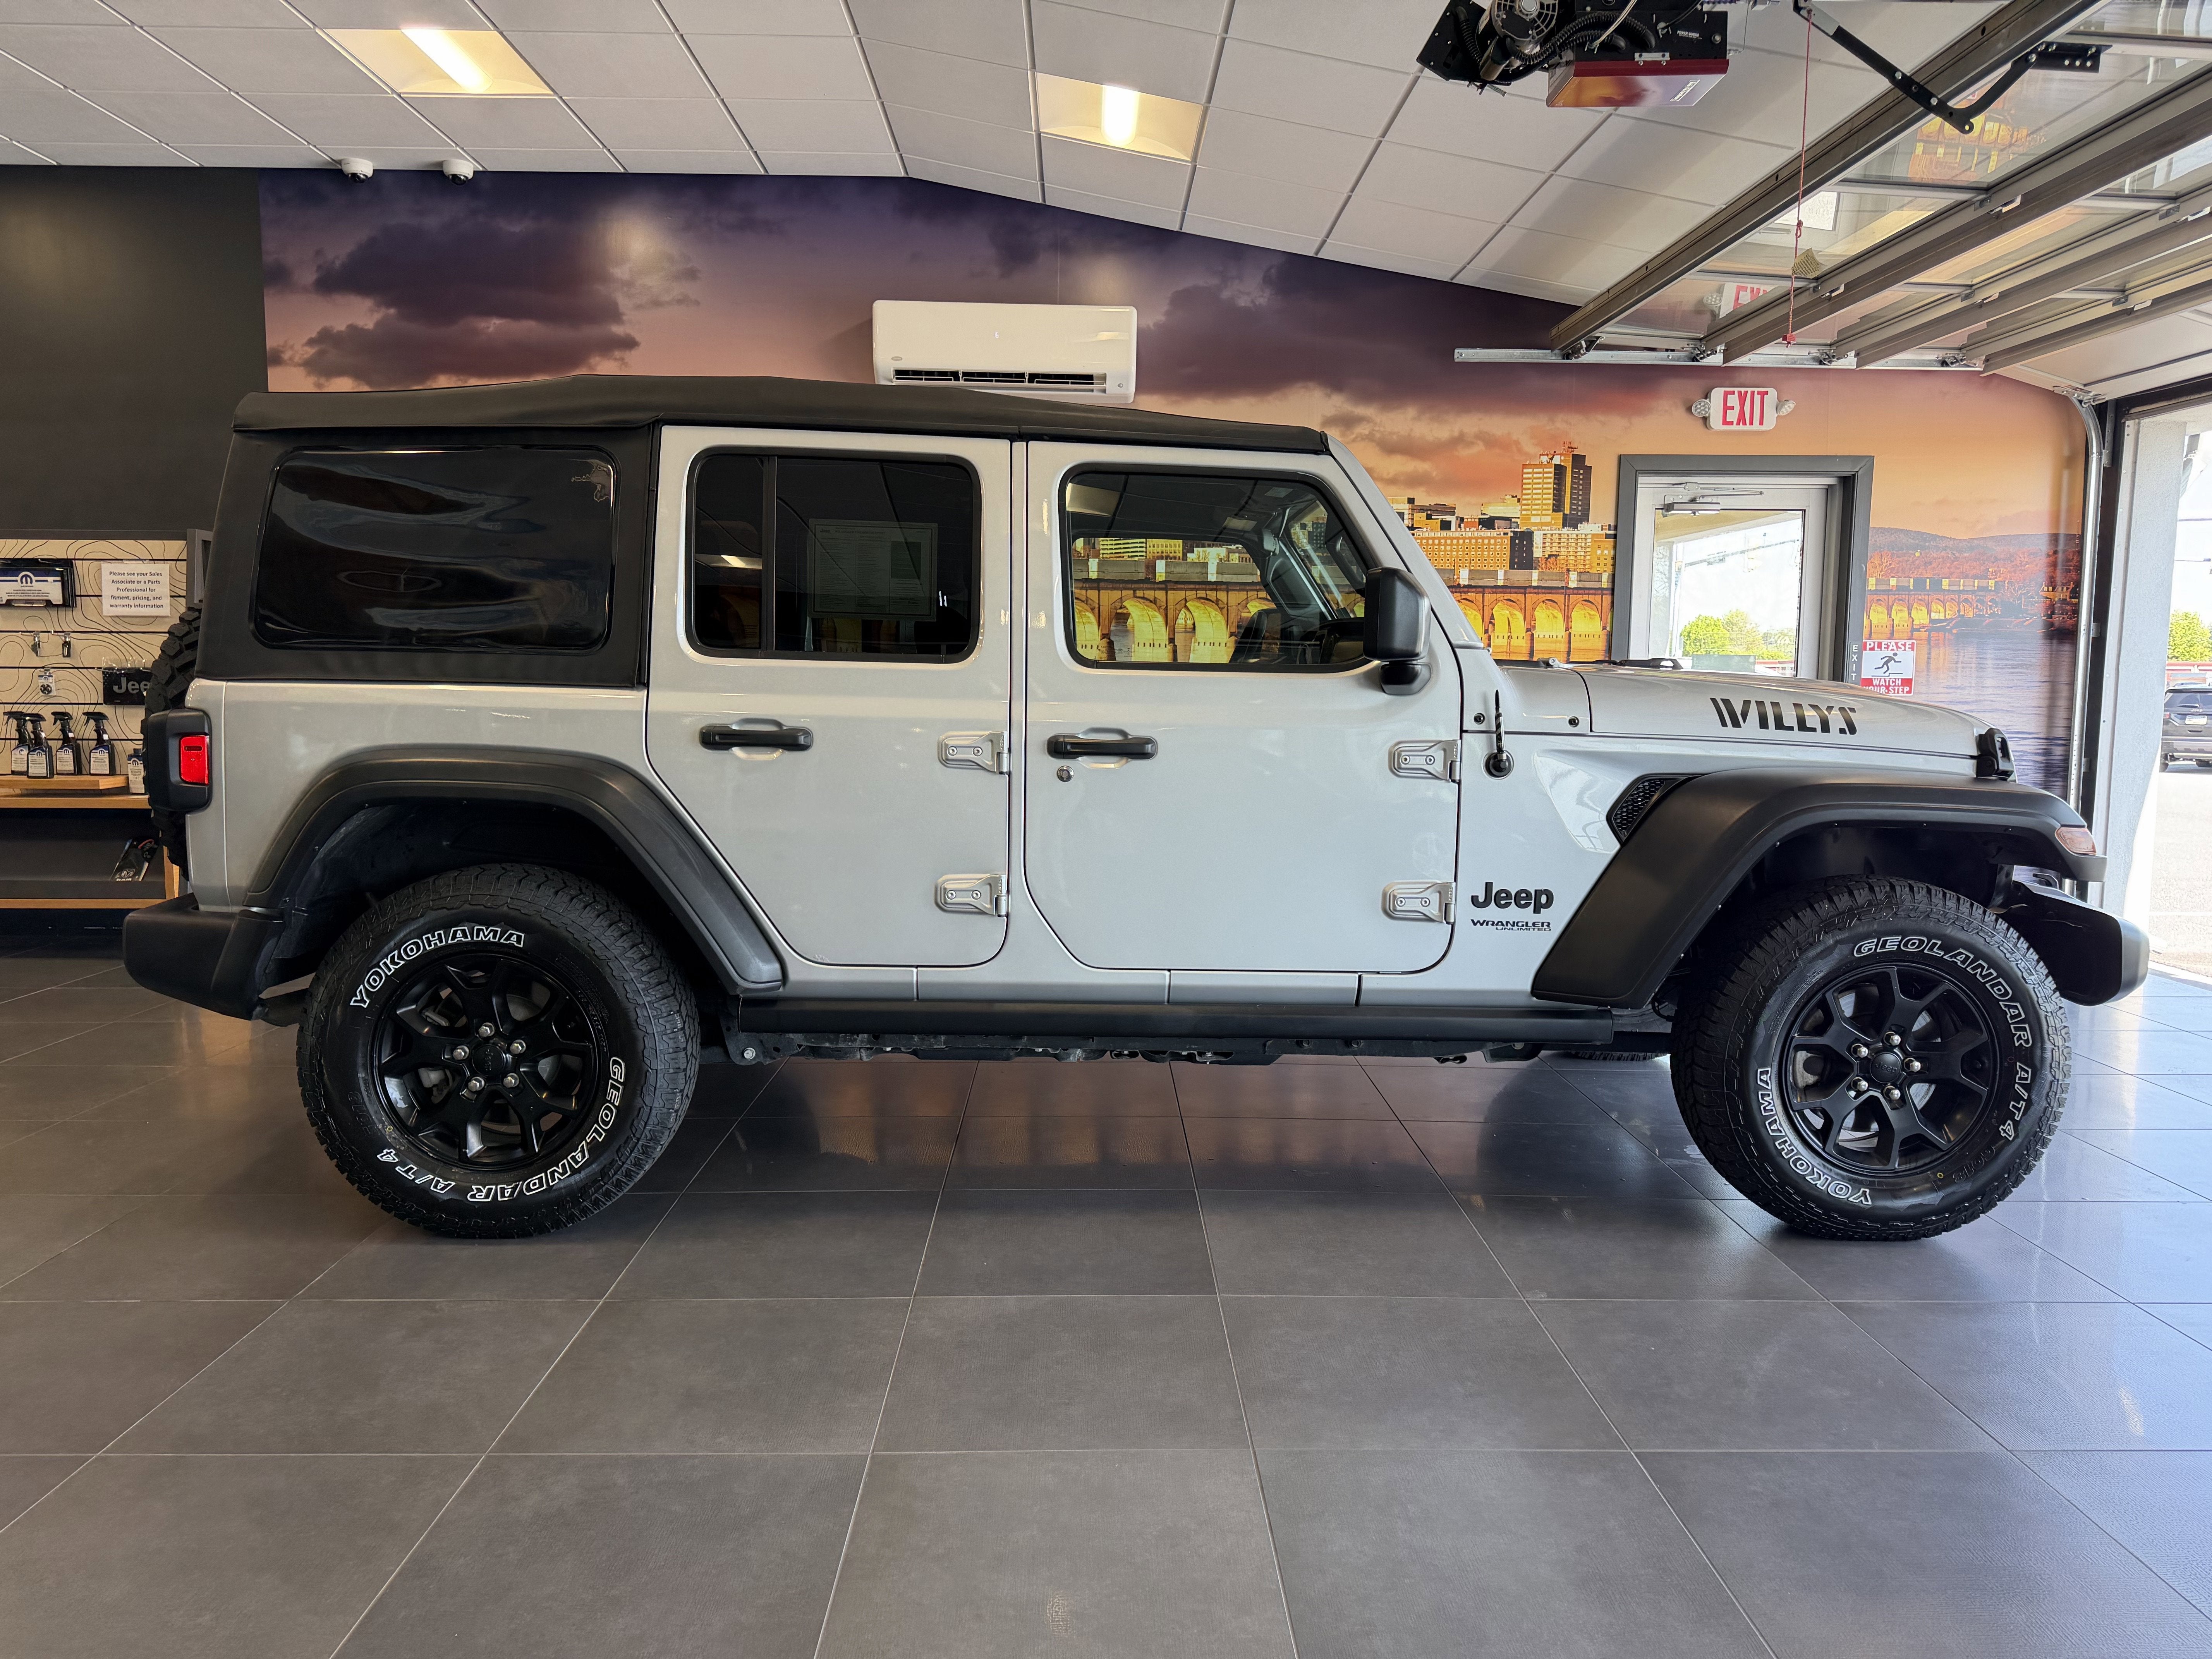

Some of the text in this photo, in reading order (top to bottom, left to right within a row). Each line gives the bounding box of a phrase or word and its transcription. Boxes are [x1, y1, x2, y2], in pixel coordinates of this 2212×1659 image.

[1722, 390, 1769, 426] EXIT
[1866, 641, 1912, 651] PLEASE
[113, 677, 150, 694] Jee
[1872, 678, 1901, 686] WATCH
[1709, 697, 1857, 735] WILLYS
[1471, 882, 1554, 914] Jeep
[1470, 919, 1551, 927] WRANGLER
[350, 926, 525, 1008] YOKOHAMA
[1853, 935, 2033, 1141] GEOLANDAR A/T4
[1875, 1061, 1898, 1074] Jeep
[377, 1056, 625, 1202] GEOLANDAR A/T4
[1757, 1067, 1872, 1205] YOKOHAMA
